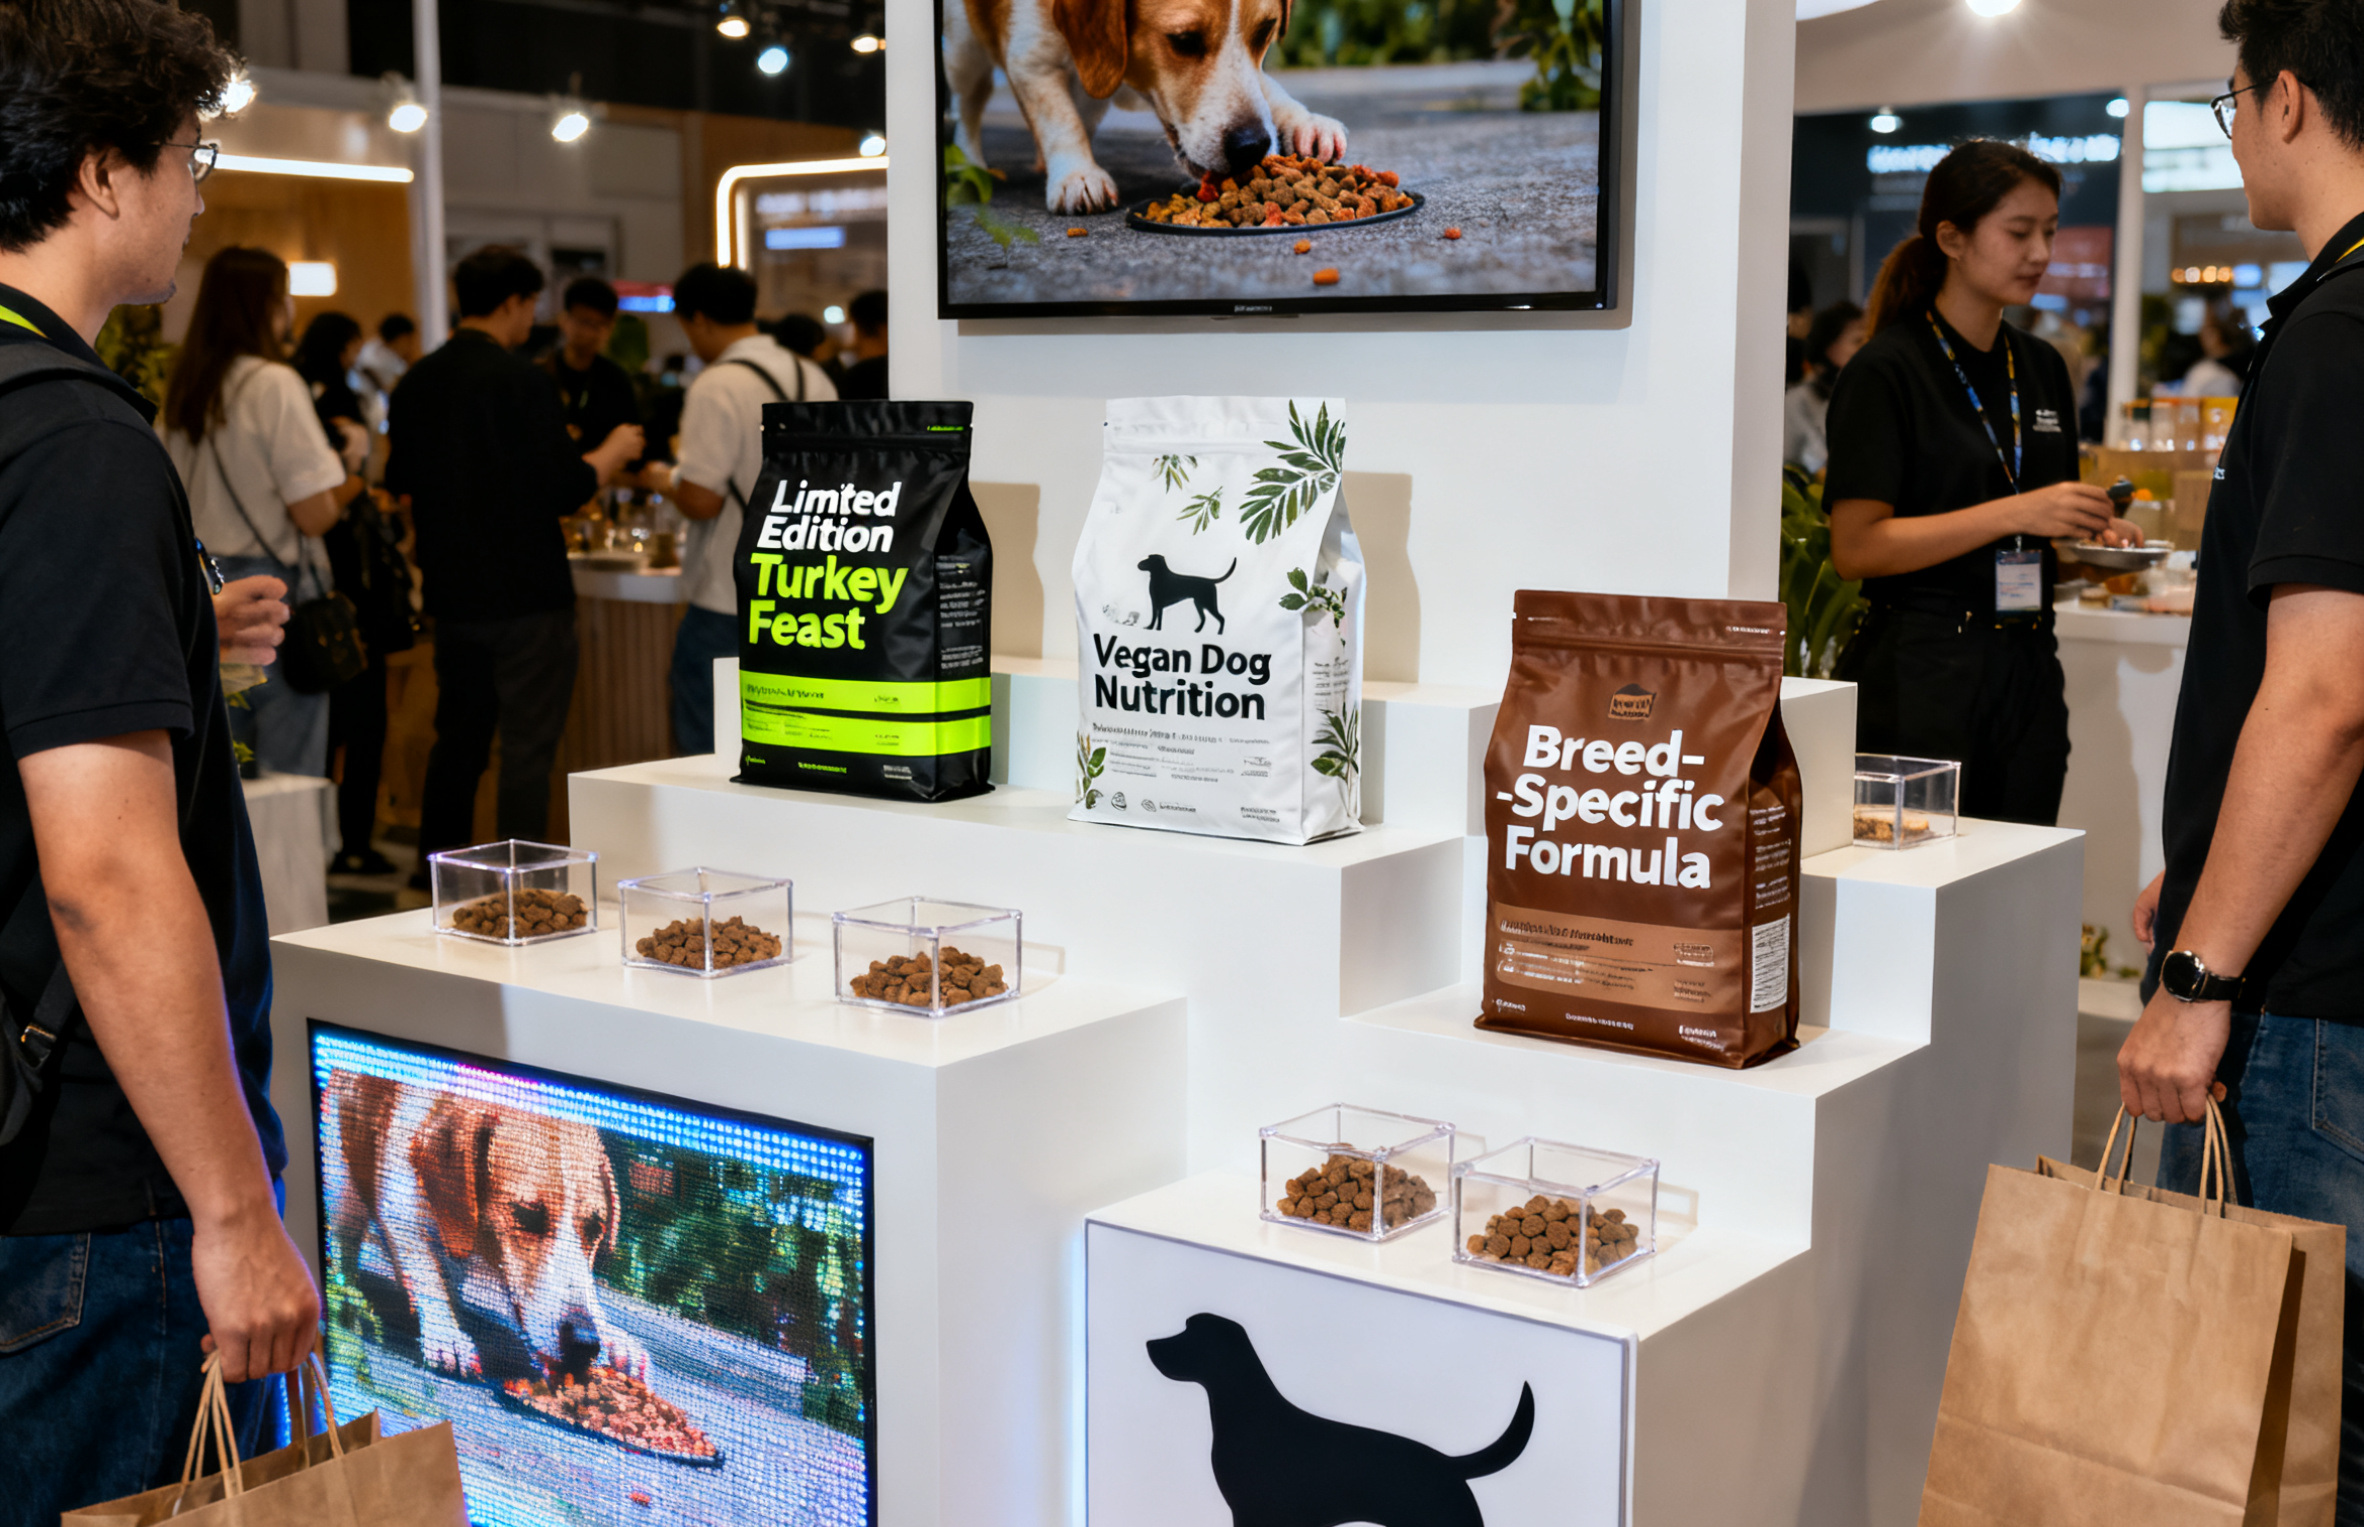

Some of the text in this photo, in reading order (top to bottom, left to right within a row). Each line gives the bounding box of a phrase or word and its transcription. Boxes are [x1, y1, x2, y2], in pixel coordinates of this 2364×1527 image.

[756, 514, 895, 553] Edition
[750, 553, 909, 615] Turkey
[749, 599, 866, 650] Feast
[1093, 633, 1192, 679] Vegan
[1201, 644, 1272, 687] Dog
[1094, 673, 1266, 721] Nutrition
[1523, 724, 1705, 778] Breed-
[1505, 824, 1712, 890] Formula
